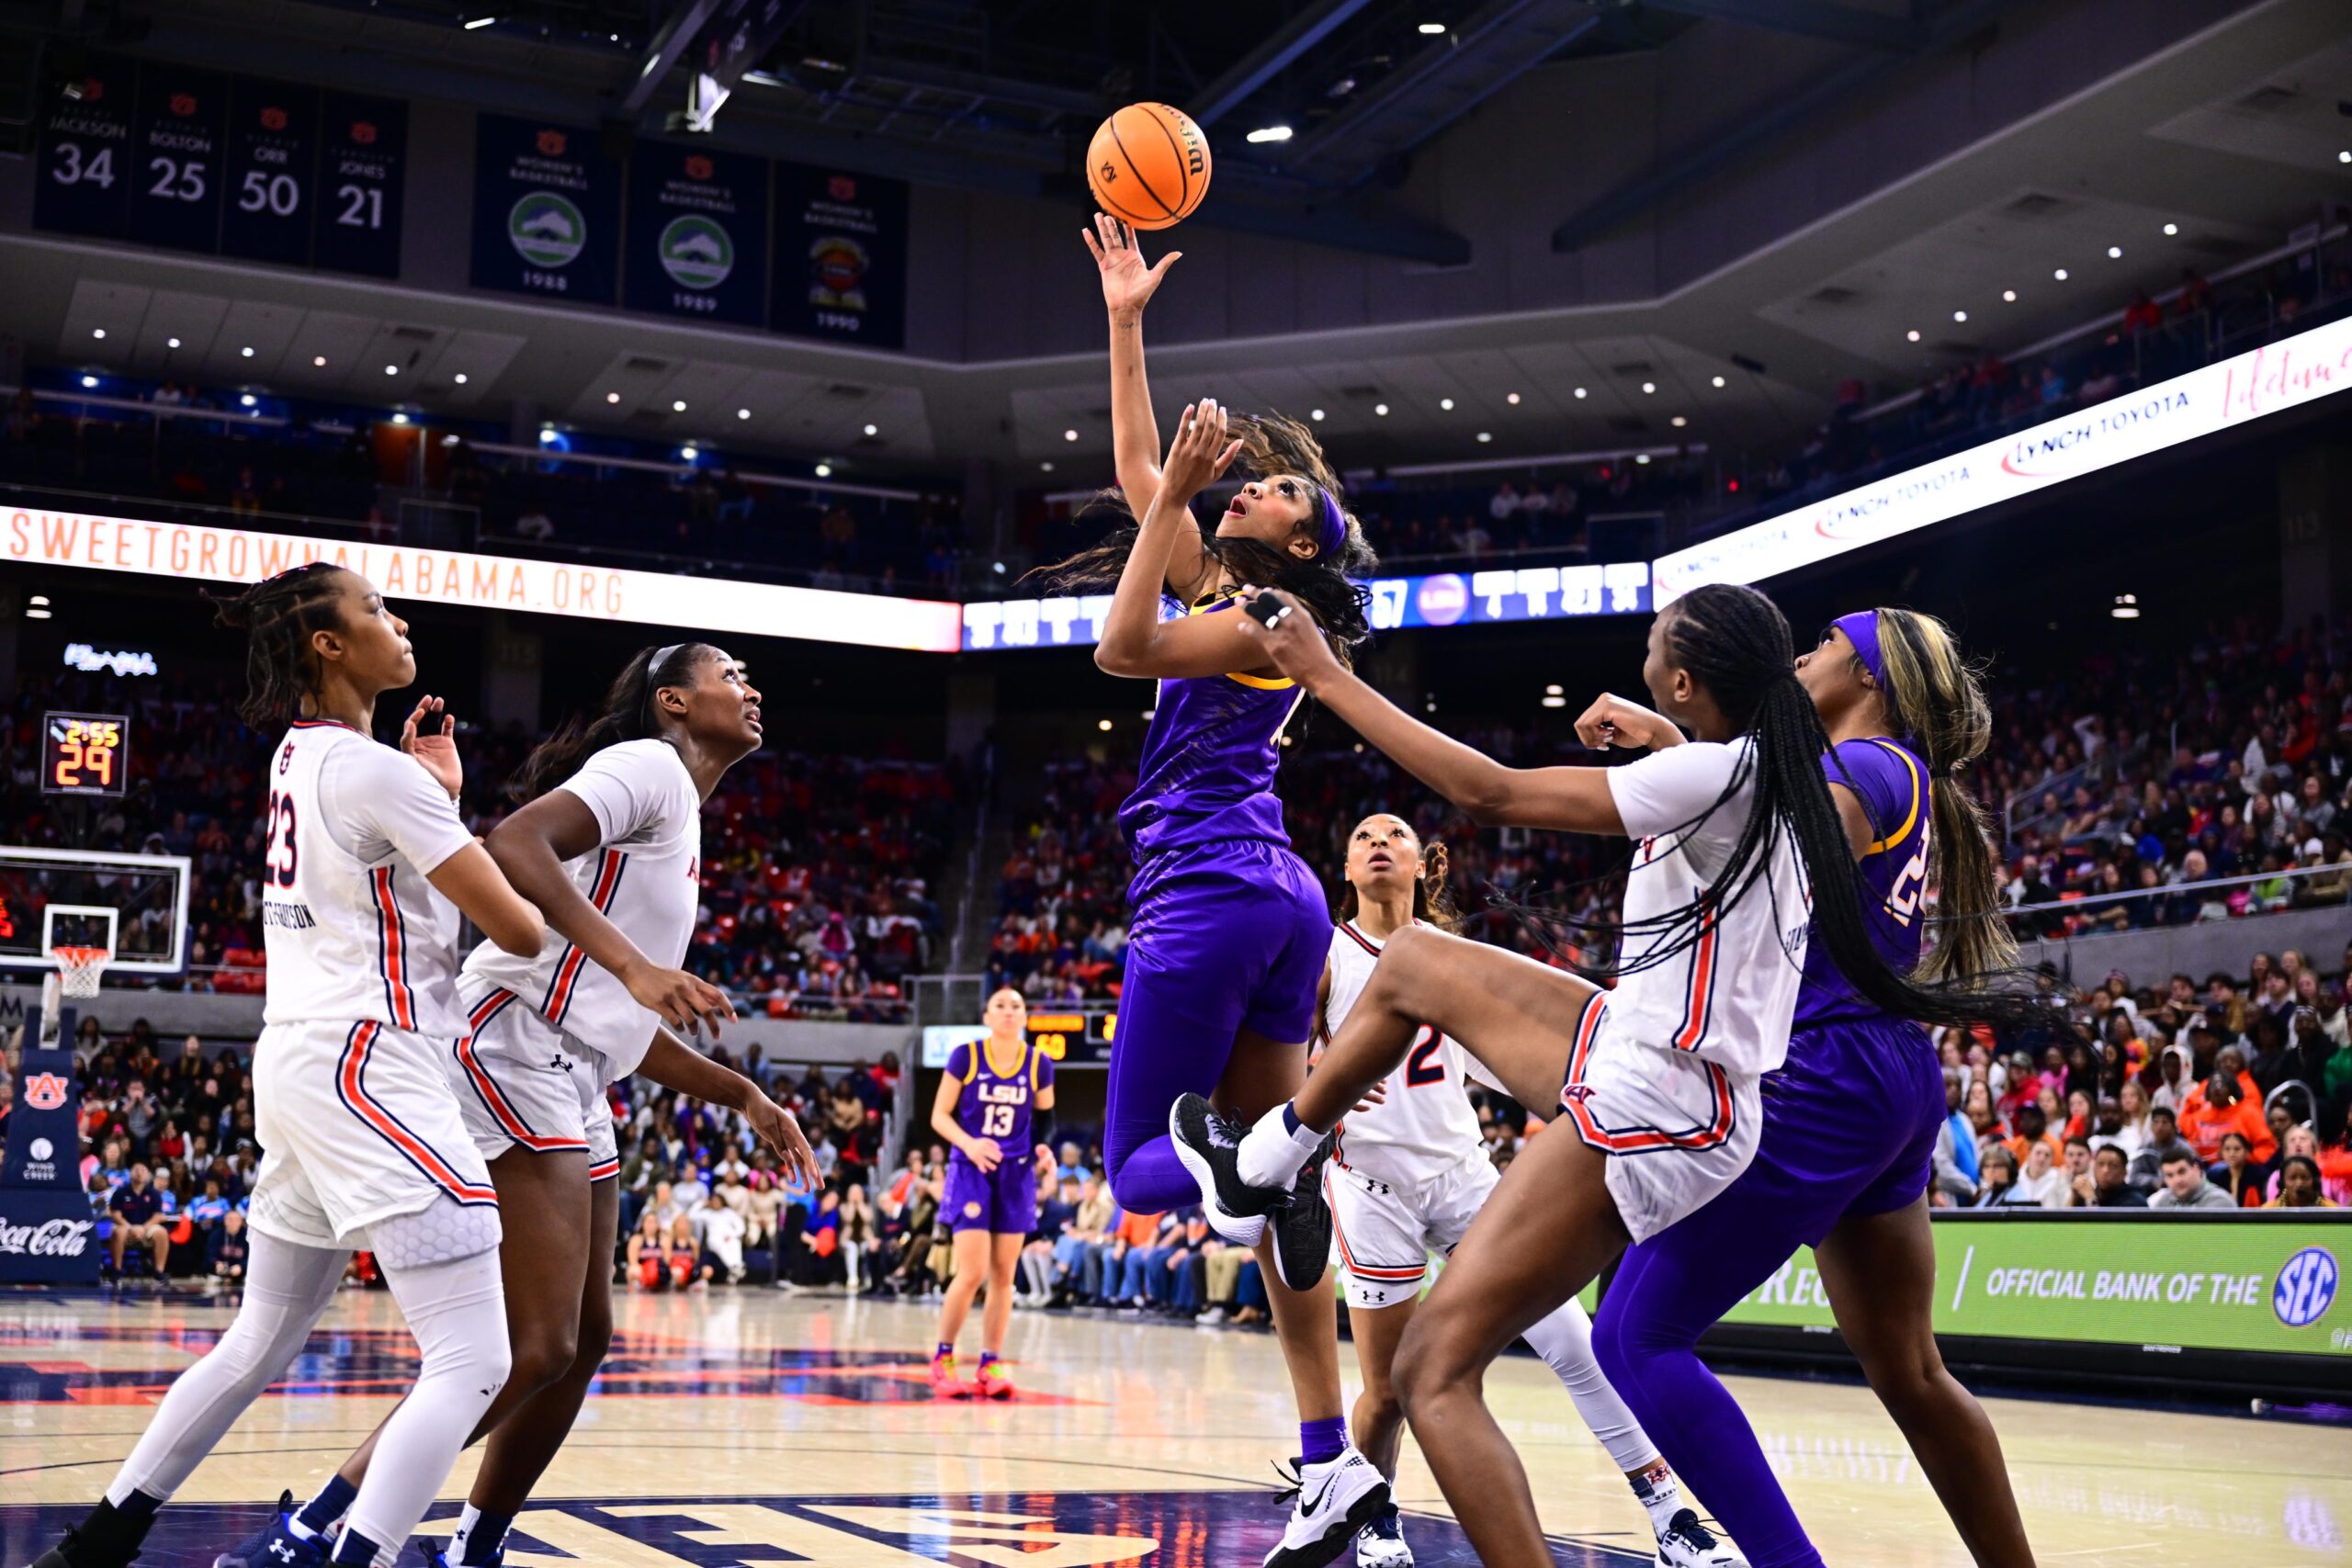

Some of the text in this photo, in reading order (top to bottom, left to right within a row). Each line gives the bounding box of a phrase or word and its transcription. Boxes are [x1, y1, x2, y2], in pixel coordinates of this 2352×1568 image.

[49, 116, 127, 141] JACKSON
[148, 130, 212, 153] BOLTON
[51, 141, 117, 190] 34
[253, 146, 289, 165] ORR
[337, 159, 388, 181] JONES
[147, 155, 207, 203] 25
[236, 170, 301, 218] 50
[335, 183, 384, 230] 21
[673, 291, 718, 314] 1989
[815, 310, 861, 332] 1990
[2014, 390, 2190, 464] LYNCH TOYOTA
[1897, 466, 1972, 501] TOYOTA
[1371, 579, 1408, 630] 57
[66, 720, 120, 748] 2:55
[56, 744, 113, 786] 29
[263, 788, 300, 891] 23
[978, 1082, 1028, 1105] LSU
[980, 1103, 1016, 1138] 13
[22, 1169, 58, 1182] CREEK
[26, 1161, 57, 1172] WIND
[0, 1216, 96, 1258] oca-Cola
[1985, 1267, 2264, 1306] OFFICIAL BANK OF THE
[2273, 1248, 2338, 1326] SEC
